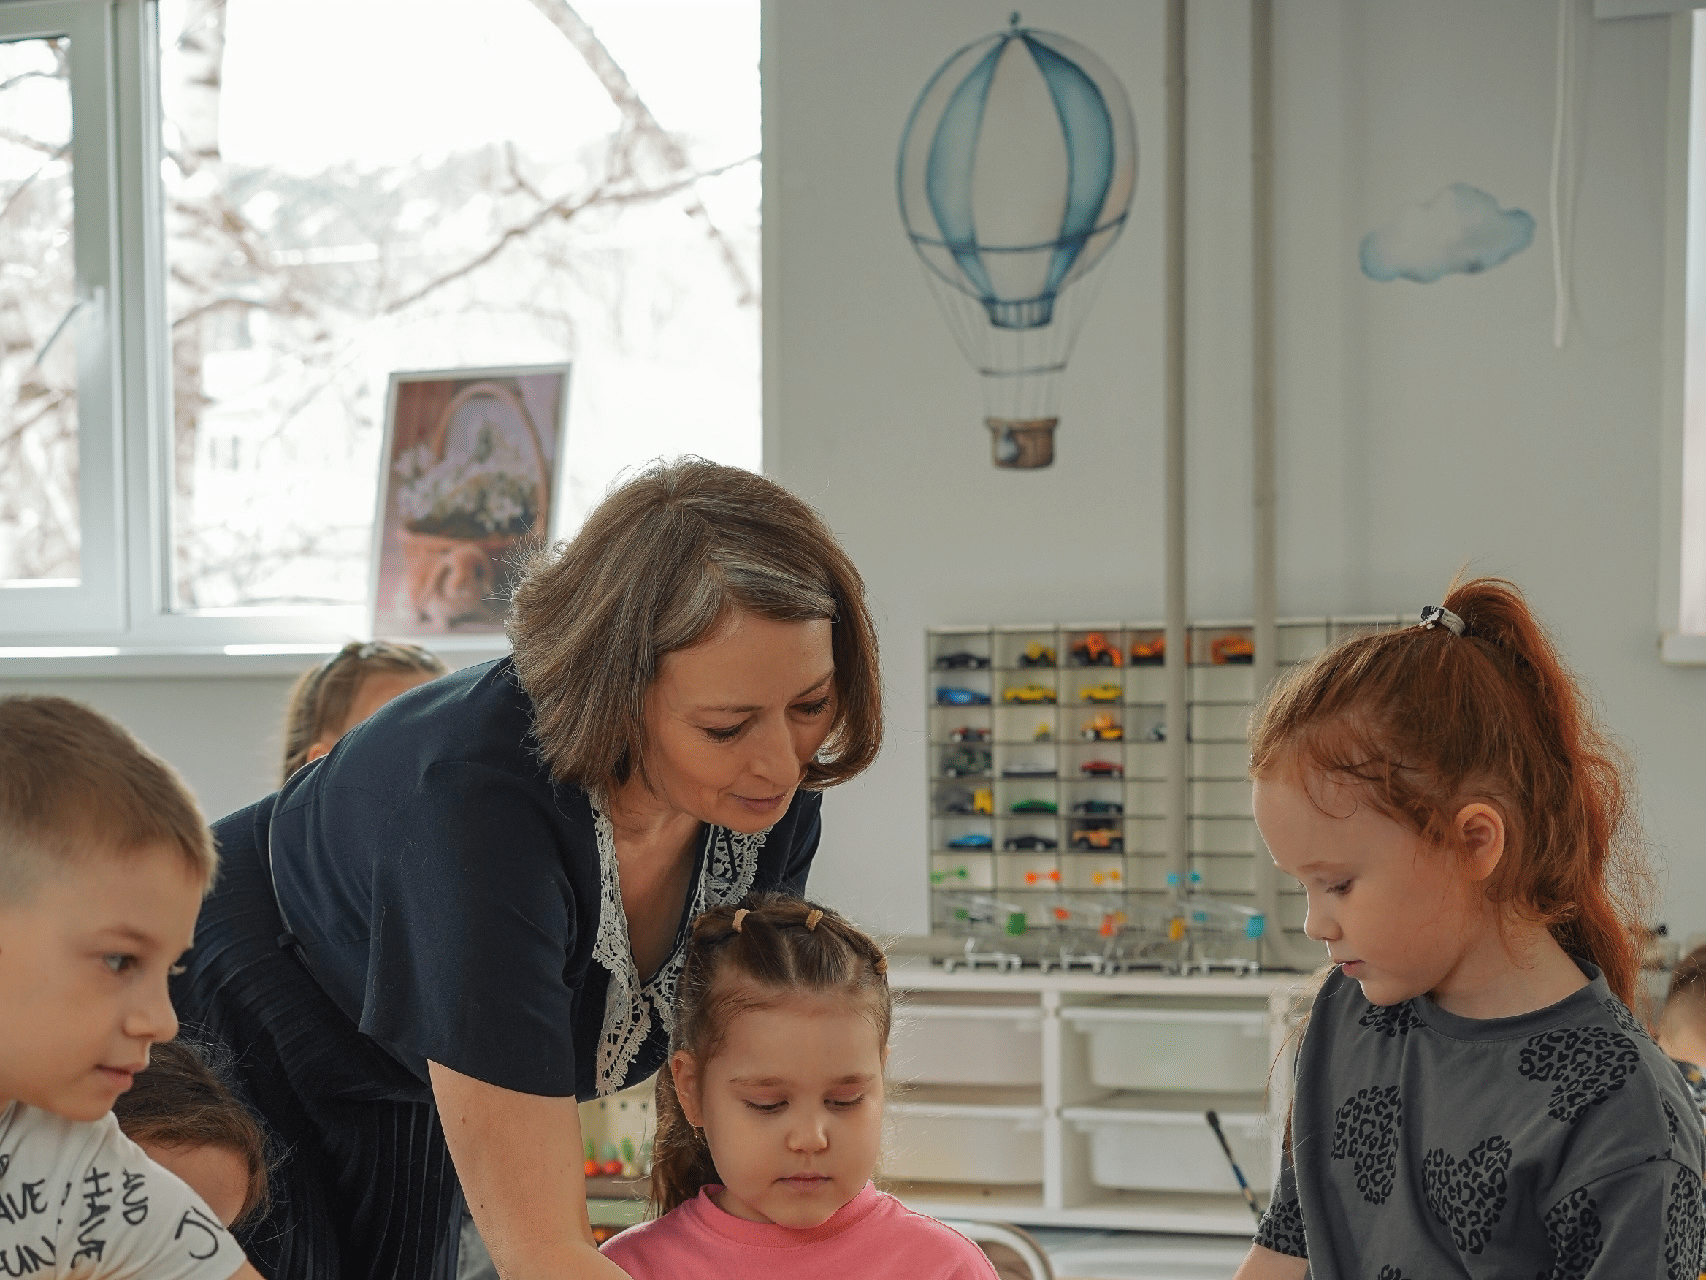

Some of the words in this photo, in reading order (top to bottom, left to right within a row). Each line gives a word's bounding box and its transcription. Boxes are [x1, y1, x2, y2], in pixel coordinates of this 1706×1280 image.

[0, 1178, 48, 1224] AVE
[71, 1167, 113, 1269] HAVE
[123, 1167, 149, 1226] AND
[0, 1235, 56, 1277] UN
